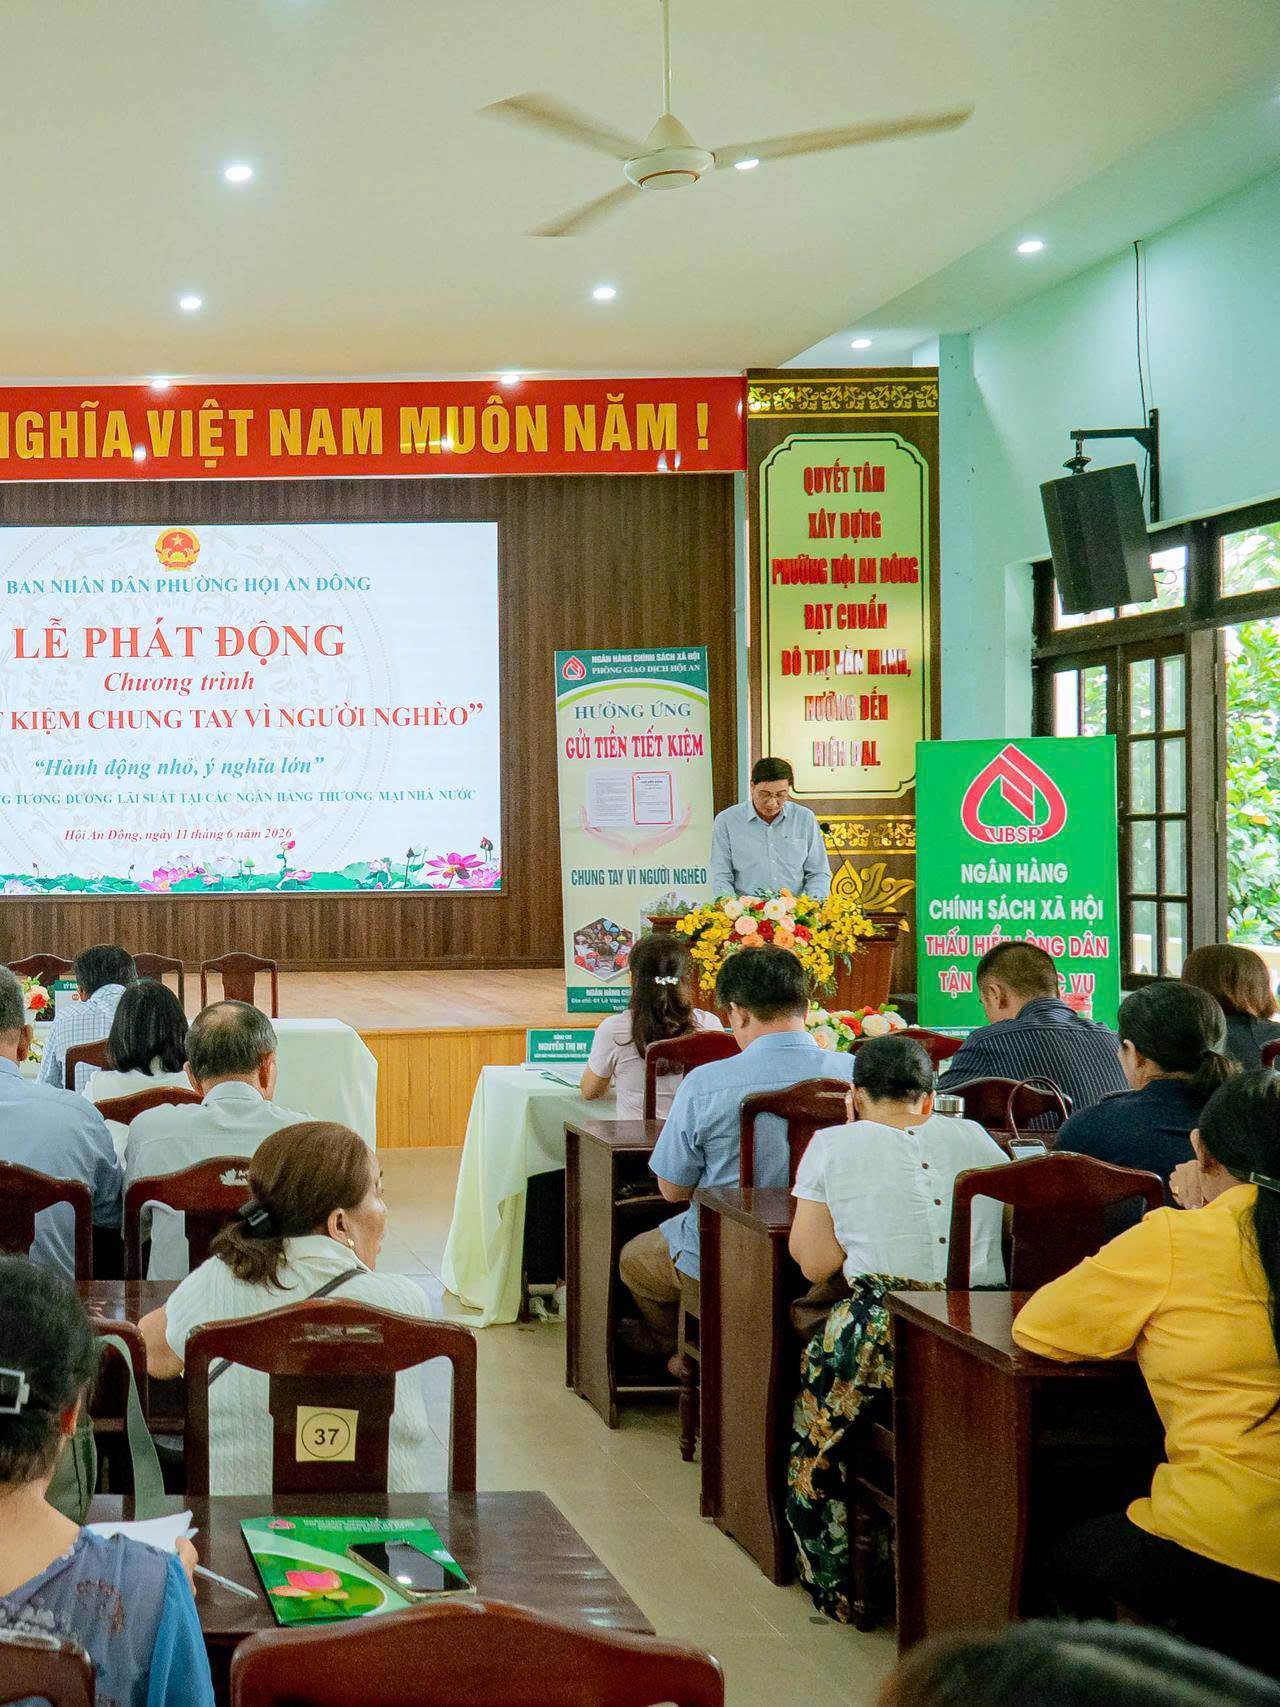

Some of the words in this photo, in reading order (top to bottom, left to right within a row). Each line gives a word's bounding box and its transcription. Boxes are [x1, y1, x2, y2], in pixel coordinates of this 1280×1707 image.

[147, 398, 251, 470] VIỆT
[270, 407, 384, 458] NAM
[399, 395, 548, 455] MUÔN
[564, 393, 679, 453] NĂM
[696, 402, 711, 452] !
[803, 458, 850, 496] QUYẾT
[853, 461, 885, 493] TÂM
[808, 508, 836, 539] XÂY
[840, 508, 881, 543] DỰNG
[7, 578, 45, 594] BAN
[51, 576, 105, 593] NHÂN
[110, 574, 150, 593] DÂN
[156, 574, 238, 592] PHƯỜNG
[244, 575, 280, 595] HỘI
[284, 577, 311, 591] AN
[316, 573, 371, 592] ĐÔNG
[772, 554, 828, 585] PHƯỜNG
[831, 553, 855, 588] HỘI
[858, 557, 876, 584] AN
[804, 603, 833, 636] ĐẠT
[11, 616, 70, 660] LỄ
[81, 616, 203, 659] PHÁT
[214, 619, 346, 666] ĐỘNG
[104, 671, 193, 697] Chương
[201, 671, 255, 692] trình
[591, 665, 622, 675] PHÒNG
[623, 665, 646, 674] GIAO
[11, 707, 81, 735] KIỆM
[88, 708, 184, 730] CHUNG
[189, 708, 238, 729] TAY
[245, 703, 271, 728] VÌ
[278, 703, 368, 728] NGƯỜI
[651, 700, 691, 718] ỨNG
[565, 727, 591, 760] GỬI
[595, 725, 628, 759] TIỀN
[632, 725, 664, 758] TIẾT
[668, 728, 704, 763] KIỆM
[104, 757, 151, 780] động
[203, 757, 215, 779] ý
[220, 756, 275, 778] nghĩa
[118, 791, 140, 804] LÃI
[180, 791, 202, 806] TẠI
[206, 790, 232, 803] CÁC
[277, 789, 313, 802] HÀNG
[319, 790, 373, 802] THƯƠNG
[378, 790, 404, 804] MẠI
[407, 787, 434, 801] NHÀ
[438, 787, 477, 801] NƯỚC
[64, 828, 86, 843] Hội
[88, 830, 105, 841] An
[145, 828, 173, 843] ngày
[176, 829, 187, 840] 11
[191, 828, 223, 842] tháng
[226, 828, 233, 839] 6
[236, 828, 262, 840] năm
[264, 827, 293, 839] 2026
[571, 868, 605, 886] CHUNG
[608, 868, 623, 885] TAY
[627, 866, 636, 885] VÌ
[639, 865, 670, 885] NGƯỜI
[673, 864, 707, 885] NGHÈO
[960, 858, 1012, 884] NGÂN
[1016, 857, 1068, 883] HÀNG
[928, 895, 984, 920] CHÍNH
[987, 894, 1035, 920] SÁCH
[1040, 894, 1066, 920] XÃ
[1070, 894, 1104, 926] HỘI
[925, 926, 968, 957] THẤU
[973, 924, 1011, 956] HIỂ
[1016, 929, 1066, 957] ÒNG
[1069, 930, 1109, 957] DÂN
[939, 966, 972, 998] TẬN
[314, 1427, 340, 1446] 37
